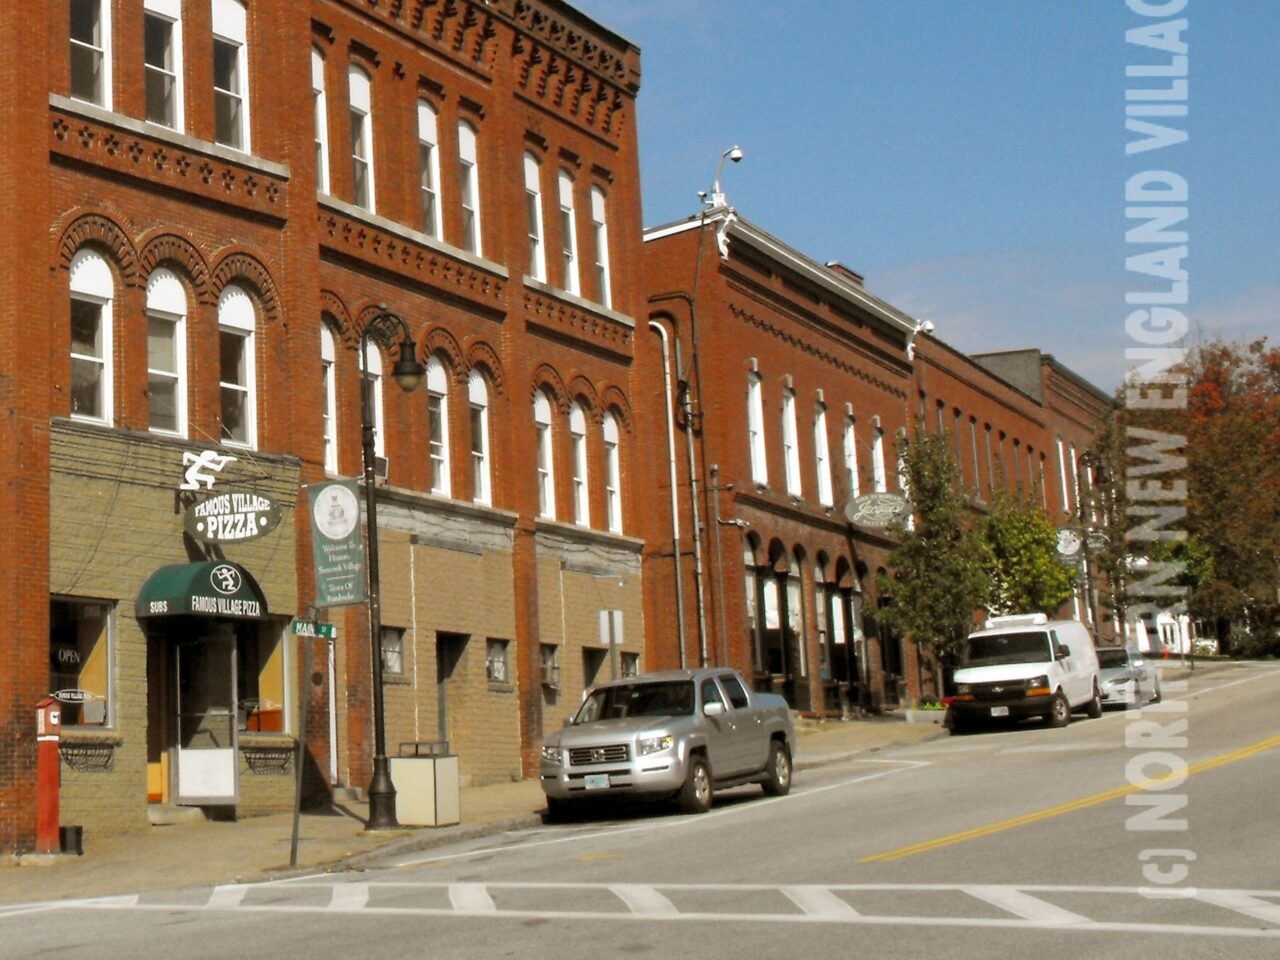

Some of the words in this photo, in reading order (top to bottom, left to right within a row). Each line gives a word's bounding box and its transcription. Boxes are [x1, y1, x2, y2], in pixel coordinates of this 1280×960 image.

[194, 494, 231, 517] FAMOUS
[231, 493, 271, 513] VILLAGE
[206, 512, 259, 540] PIZZA
[149, 601, 168, 613] SUBS
[191, 595, 218, 613] FAMOUS
[217, 598, 242, 615] VILLAGE
[242, 600, 261, 616] PIZZA
[295, 622, 315, 635] MAIN
[58, 648, 81, 663] OPEN
